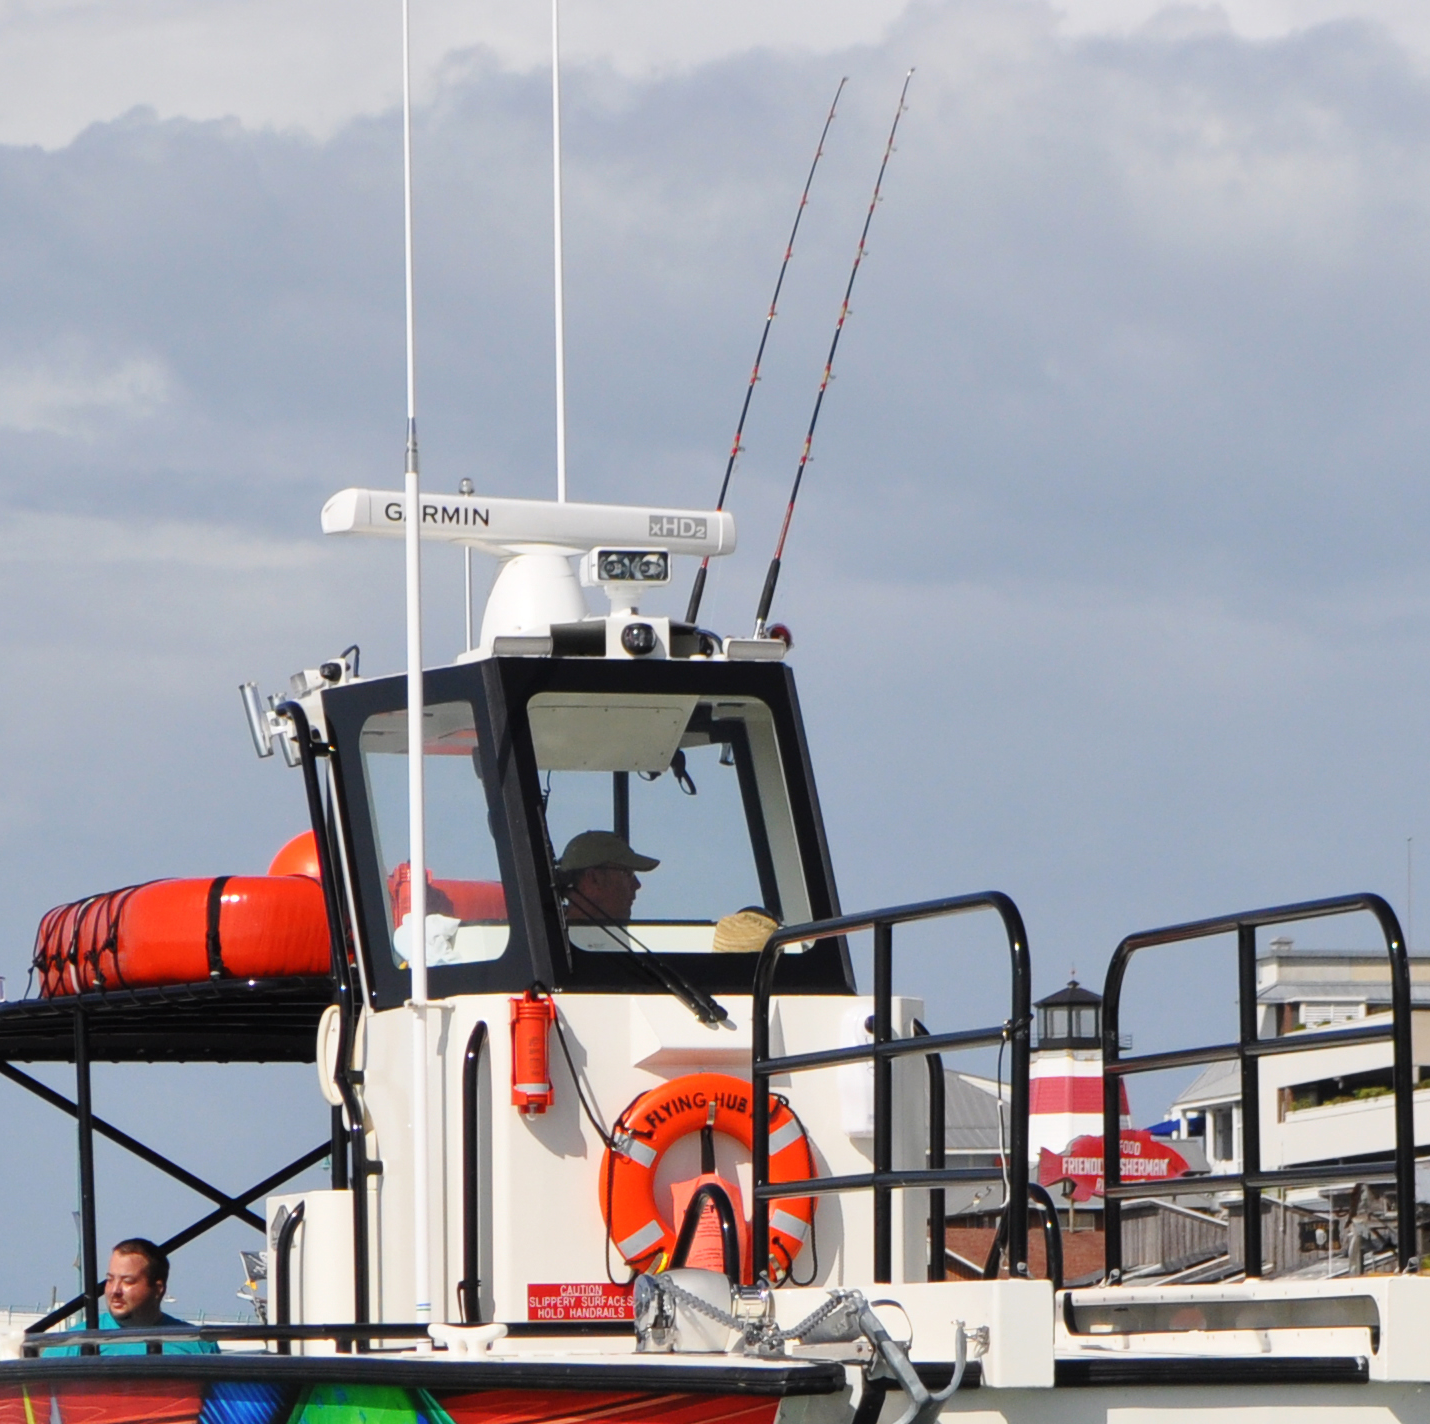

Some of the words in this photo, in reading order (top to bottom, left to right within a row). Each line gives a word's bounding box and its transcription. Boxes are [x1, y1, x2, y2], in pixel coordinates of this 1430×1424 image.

[384, 502, 490, 527] GRMIN
[644, 1092, 707, 1129] FLYING
[714, 1092, 749, 1114] HUB
[1061, 1156, 1105, 1176] FRIENDL
[1119, 1157, 1169, 1176] SHERMAN
[559, 1284, 603, 1296] CAUTION
[529, 1296, 576, 1308] SLIPPERY
[581, 1295, 635, 1307] SURFACES
[537, 1307, 565, 1318] HOLD
[569, 1306, 625, 1318] HANDRAILS
